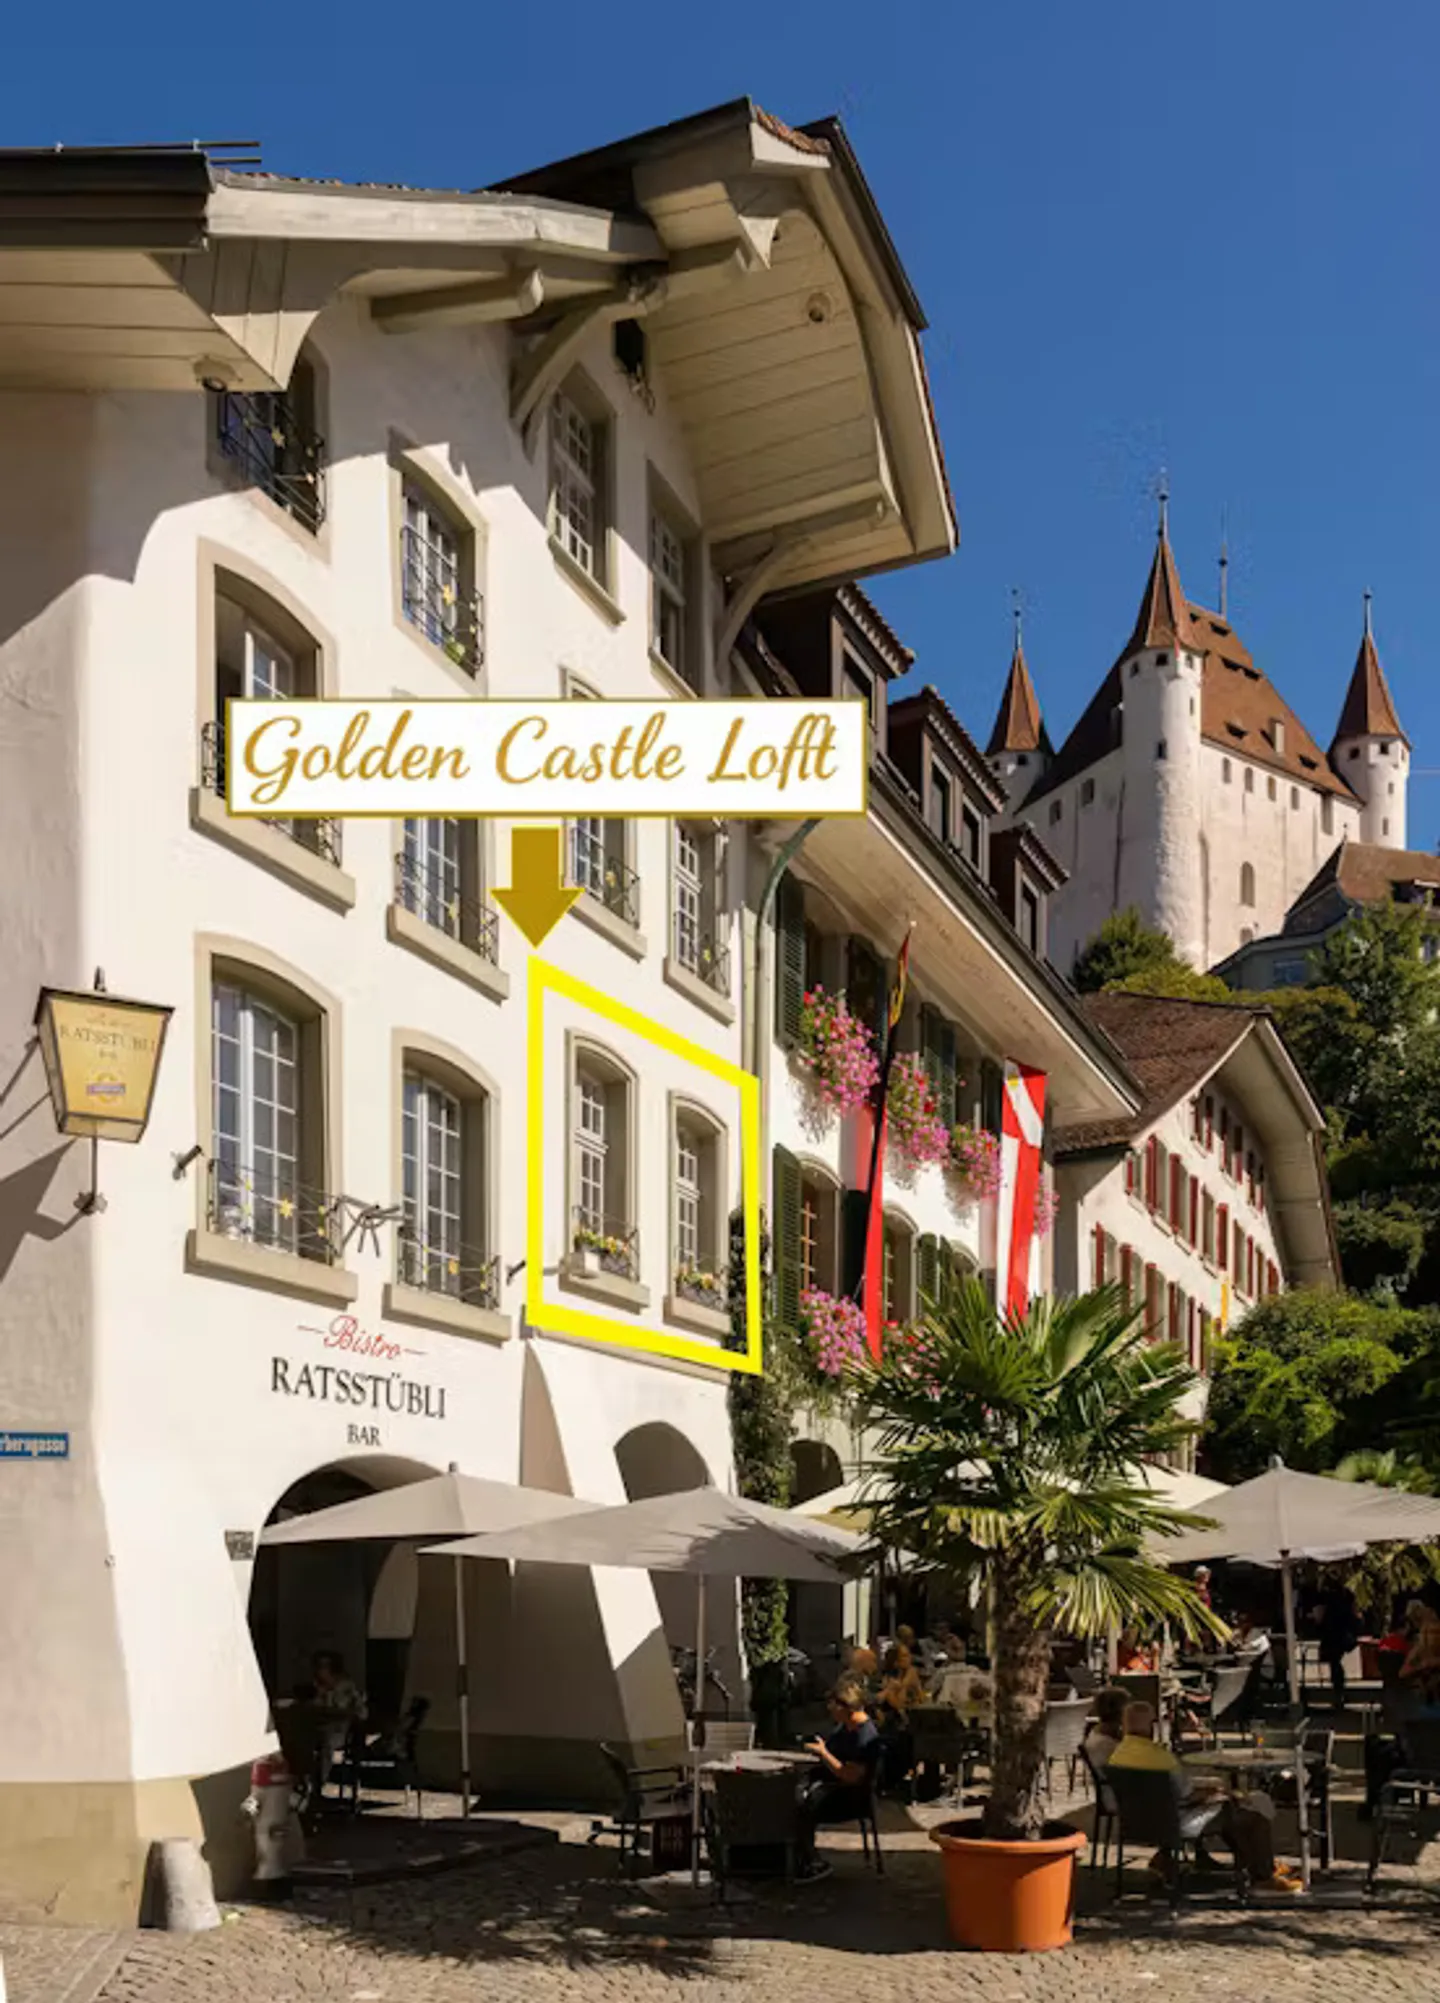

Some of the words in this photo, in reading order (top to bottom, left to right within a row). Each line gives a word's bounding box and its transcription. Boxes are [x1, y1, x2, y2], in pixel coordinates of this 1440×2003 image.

[323, 1315, 401, 1360] Bistro
[271, 1356, 446, 1419] RATSSTÜBLI
[347, 1423, 381, 1447] BAR
